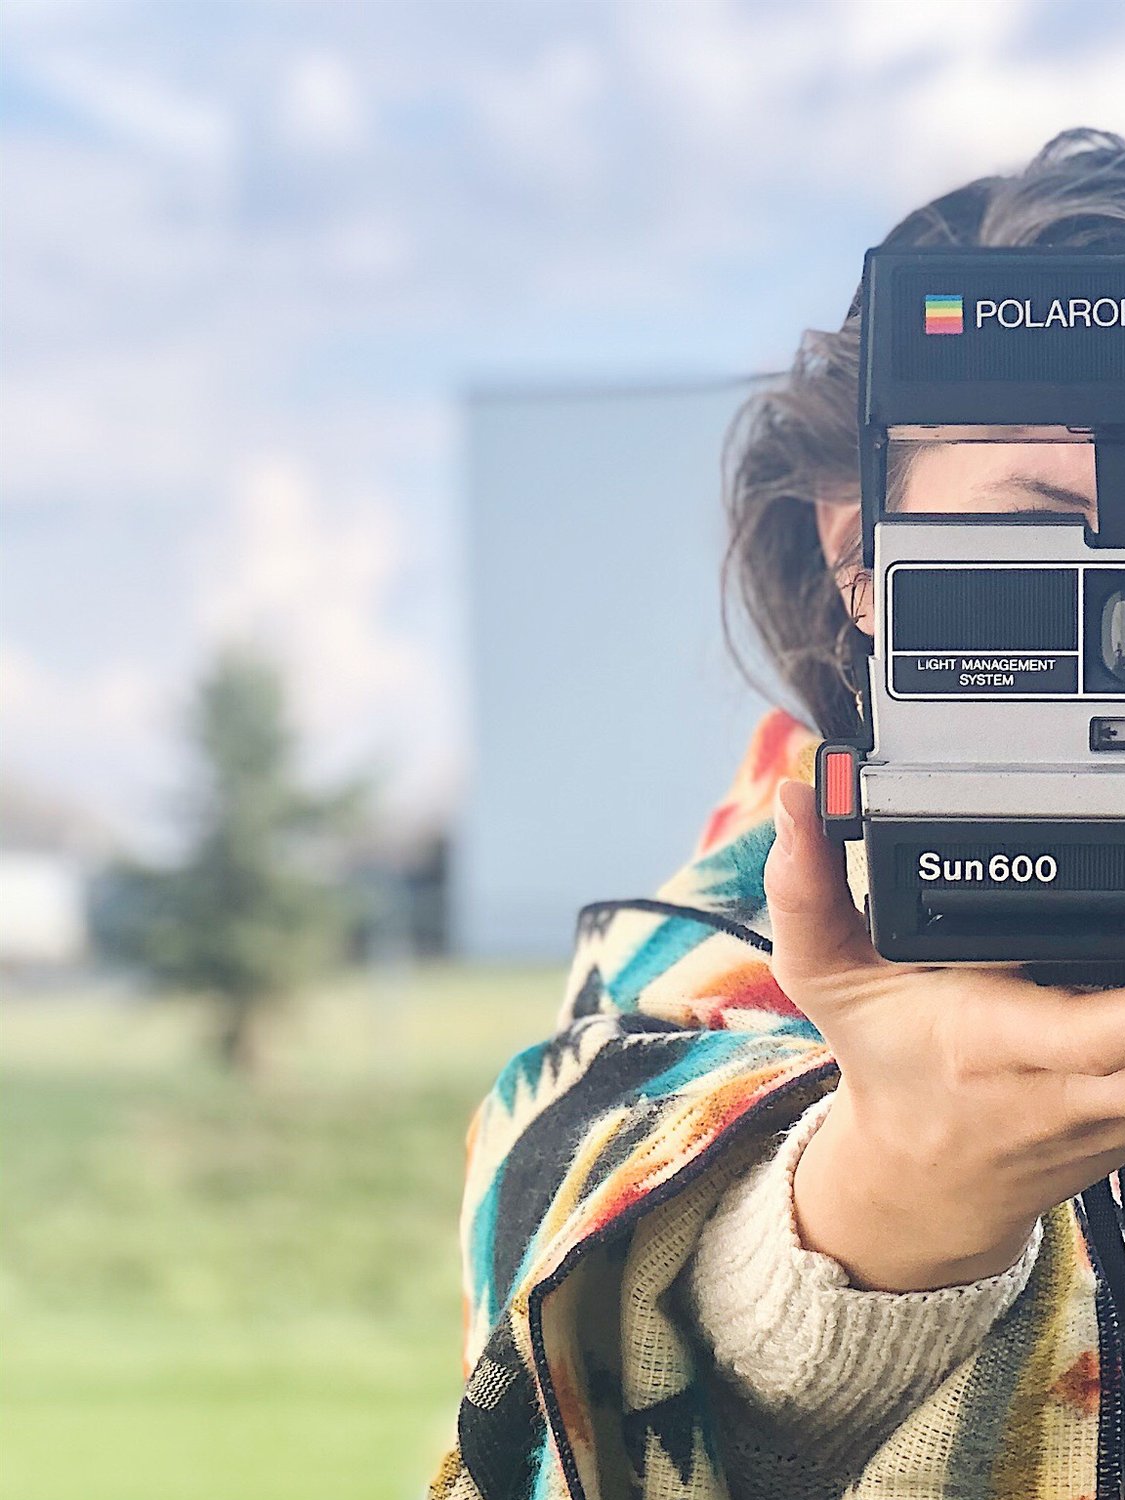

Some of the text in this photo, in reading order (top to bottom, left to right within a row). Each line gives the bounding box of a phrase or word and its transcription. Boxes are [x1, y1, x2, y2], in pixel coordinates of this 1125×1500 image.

[917, 658, 1056, 671] LIGHT MANAGEMENT
[959, 673, 1015, 686] SYSTEM
